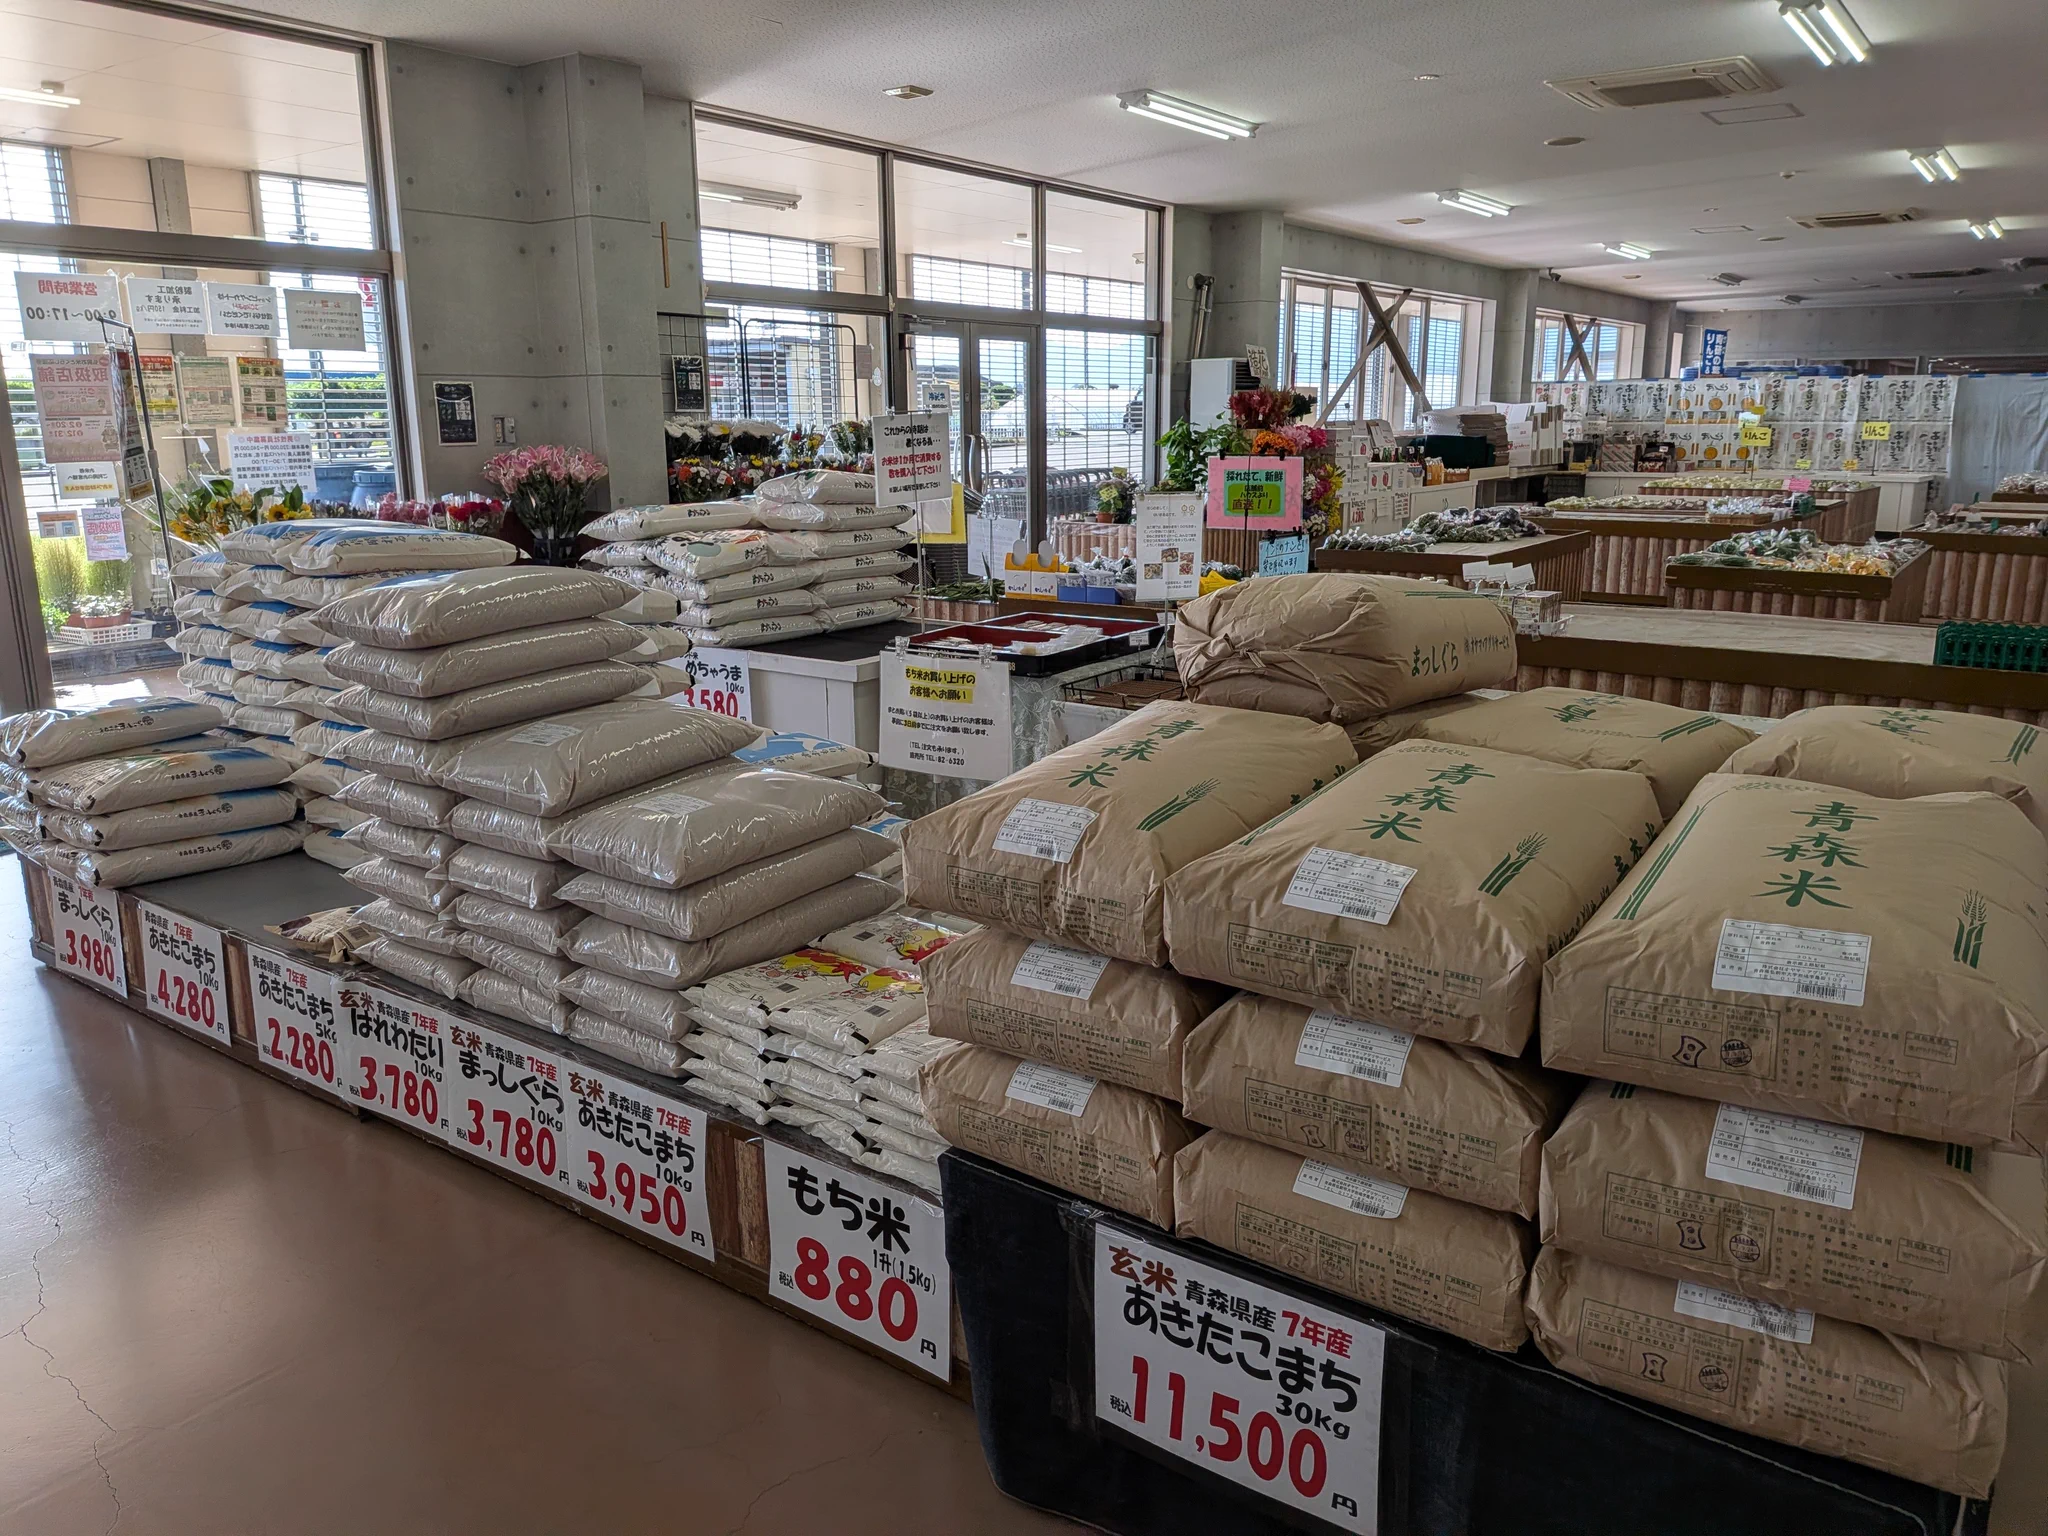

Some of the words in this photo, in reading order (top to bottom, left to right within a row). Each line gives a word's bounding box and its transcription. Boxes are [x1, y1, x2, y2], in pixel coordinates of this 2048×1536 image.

[685, 661, 742, 681] めちゃうま
[905, 669, 975, 684] もち米お買い上げの
[1412, 642, 1459, 676] まっしぐら
[726, 682, 744, 694] 10kg
[910, 685, 966, 700] お客様へお願い
[53, 876, 74, 893] 青森県産
[58, 891, 113, 930] まっしぐら
[144, 910, 169, 930] 青森県産
[174, 922, 193, 941] 7年産
[65, 930, 114, 982] 3,980
[116, 976, 123, 987] 円
[100, 929, 116, 946] 10kg
[149, 928, 216, 974] あきたこまち
[198, 970, 219, 991] 10kg
[252, 954, 281, 977] 青森県産
[286, 967, 308, 989] 7年産
[158, 969, 215, 1027] 4,280
[217, 1022, 225, 1034] 円
[258, 972, 335, 1025] あきたこまち
[337, 989, 374, 1011] 玄米
[376, 1000, 410, 1025] 青森県産
[411, 1012, 439, 1035] 7年産
[267, 1017, 334, 1083] 2,280
[315, 1021, 338, 1043] 5kg
[350, 1008, 444, 1068] はれわたり
[449, 1026, 483, 1053] 玄米
[485, 1042, 526, 1071] 青森県産
[526, 1056, 558, 1082] 7年産
[360, 1056, 438, 1124] 3,780
[440, 1118, 449, 1131] 円
[414, 1059, 442, 1082] 10kg
[458, 1049, 565, 1114] まっしぐら
[530, 1106, 563, 1132] 10kg
[567, 1072, 605, 1103] 玄米
[608, 1091, 654, 1122] 青森県産
[655, 1108, 692, 1137] 7年産
[467, 1099, 557, 1176] 3,780
[559, 1170, 569, 1185] 円
[578, 1098, 696, 1174] あきたこまち
[588, 1149, 686, 1237] 3,950
[691, 1230, 705, 1247] 円
[655, 1163, 692, 1193] 10kg
[787, 1165, 911, 1254] もち米
[872, 1249, 936, 1295] 1升(1.5kg)
[778, 1271, 794, 1290] 税込
[794, 1236, 919, 1342] 880
[920, 1338, 937, 1360] 円
[1108, 1245, 1177, 1296] 玄米
[1184, 1278, 1276, 1333] 青森県産
[1281, 1310, 1352, 1359] 7年産
[1122, 1284, 1361, 1413] あきたこまち
[1109, 1394, 1132, 1418] 税込
[1131, 1355, 1327, 1498] 11,500
[1330, 1492, 1357, 1518] 円
[1274, 1394, 1350, 1440] 30kg
